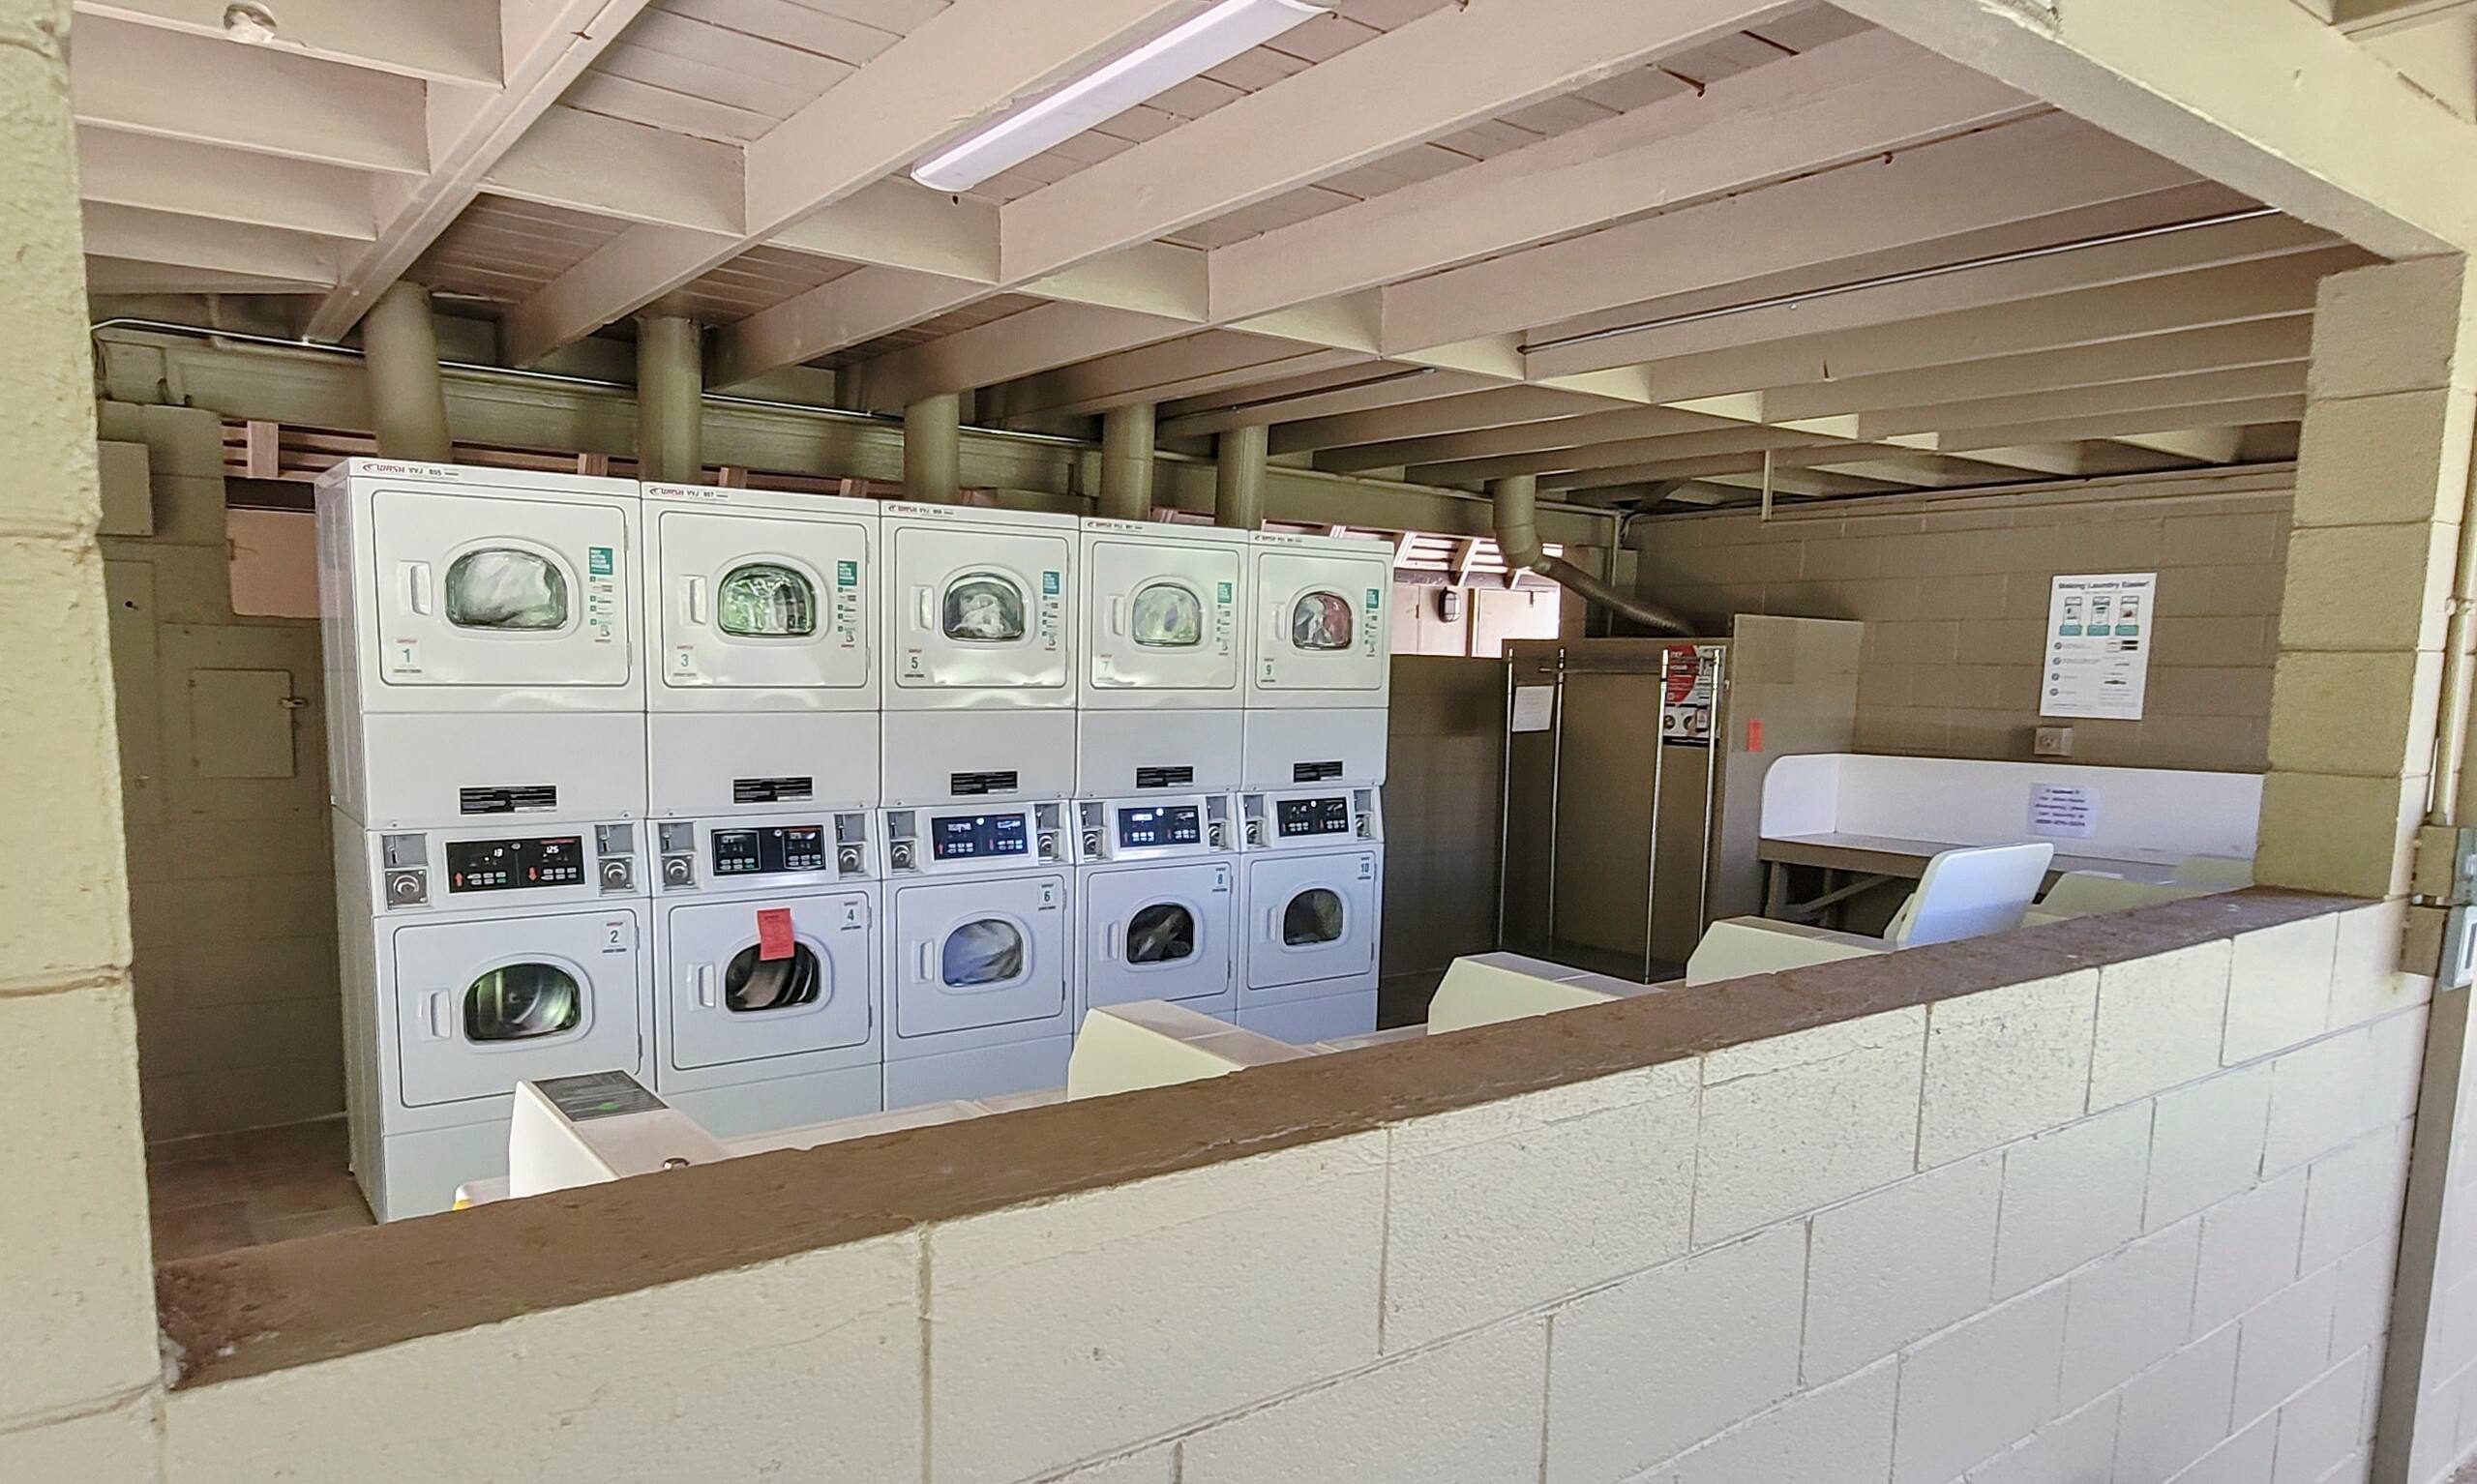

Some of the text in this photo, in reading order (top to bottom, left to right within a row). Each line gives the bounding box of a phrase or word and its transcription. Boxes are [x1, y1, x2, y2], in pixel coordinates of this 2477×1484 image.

[402, 648, 410, 664] 1
[680, 653, 689, 668] 3
[910, 656, 918, 669] 5
[1102, 660, 1110, 672] 7
[1266, 664, 1271, 675] 9
[1360, 862, 1369, 873] 10
[1044, 890, 1051, 903] 6
[847, 908, 854, 921] 4
[610, 930, 619, 943] 2
